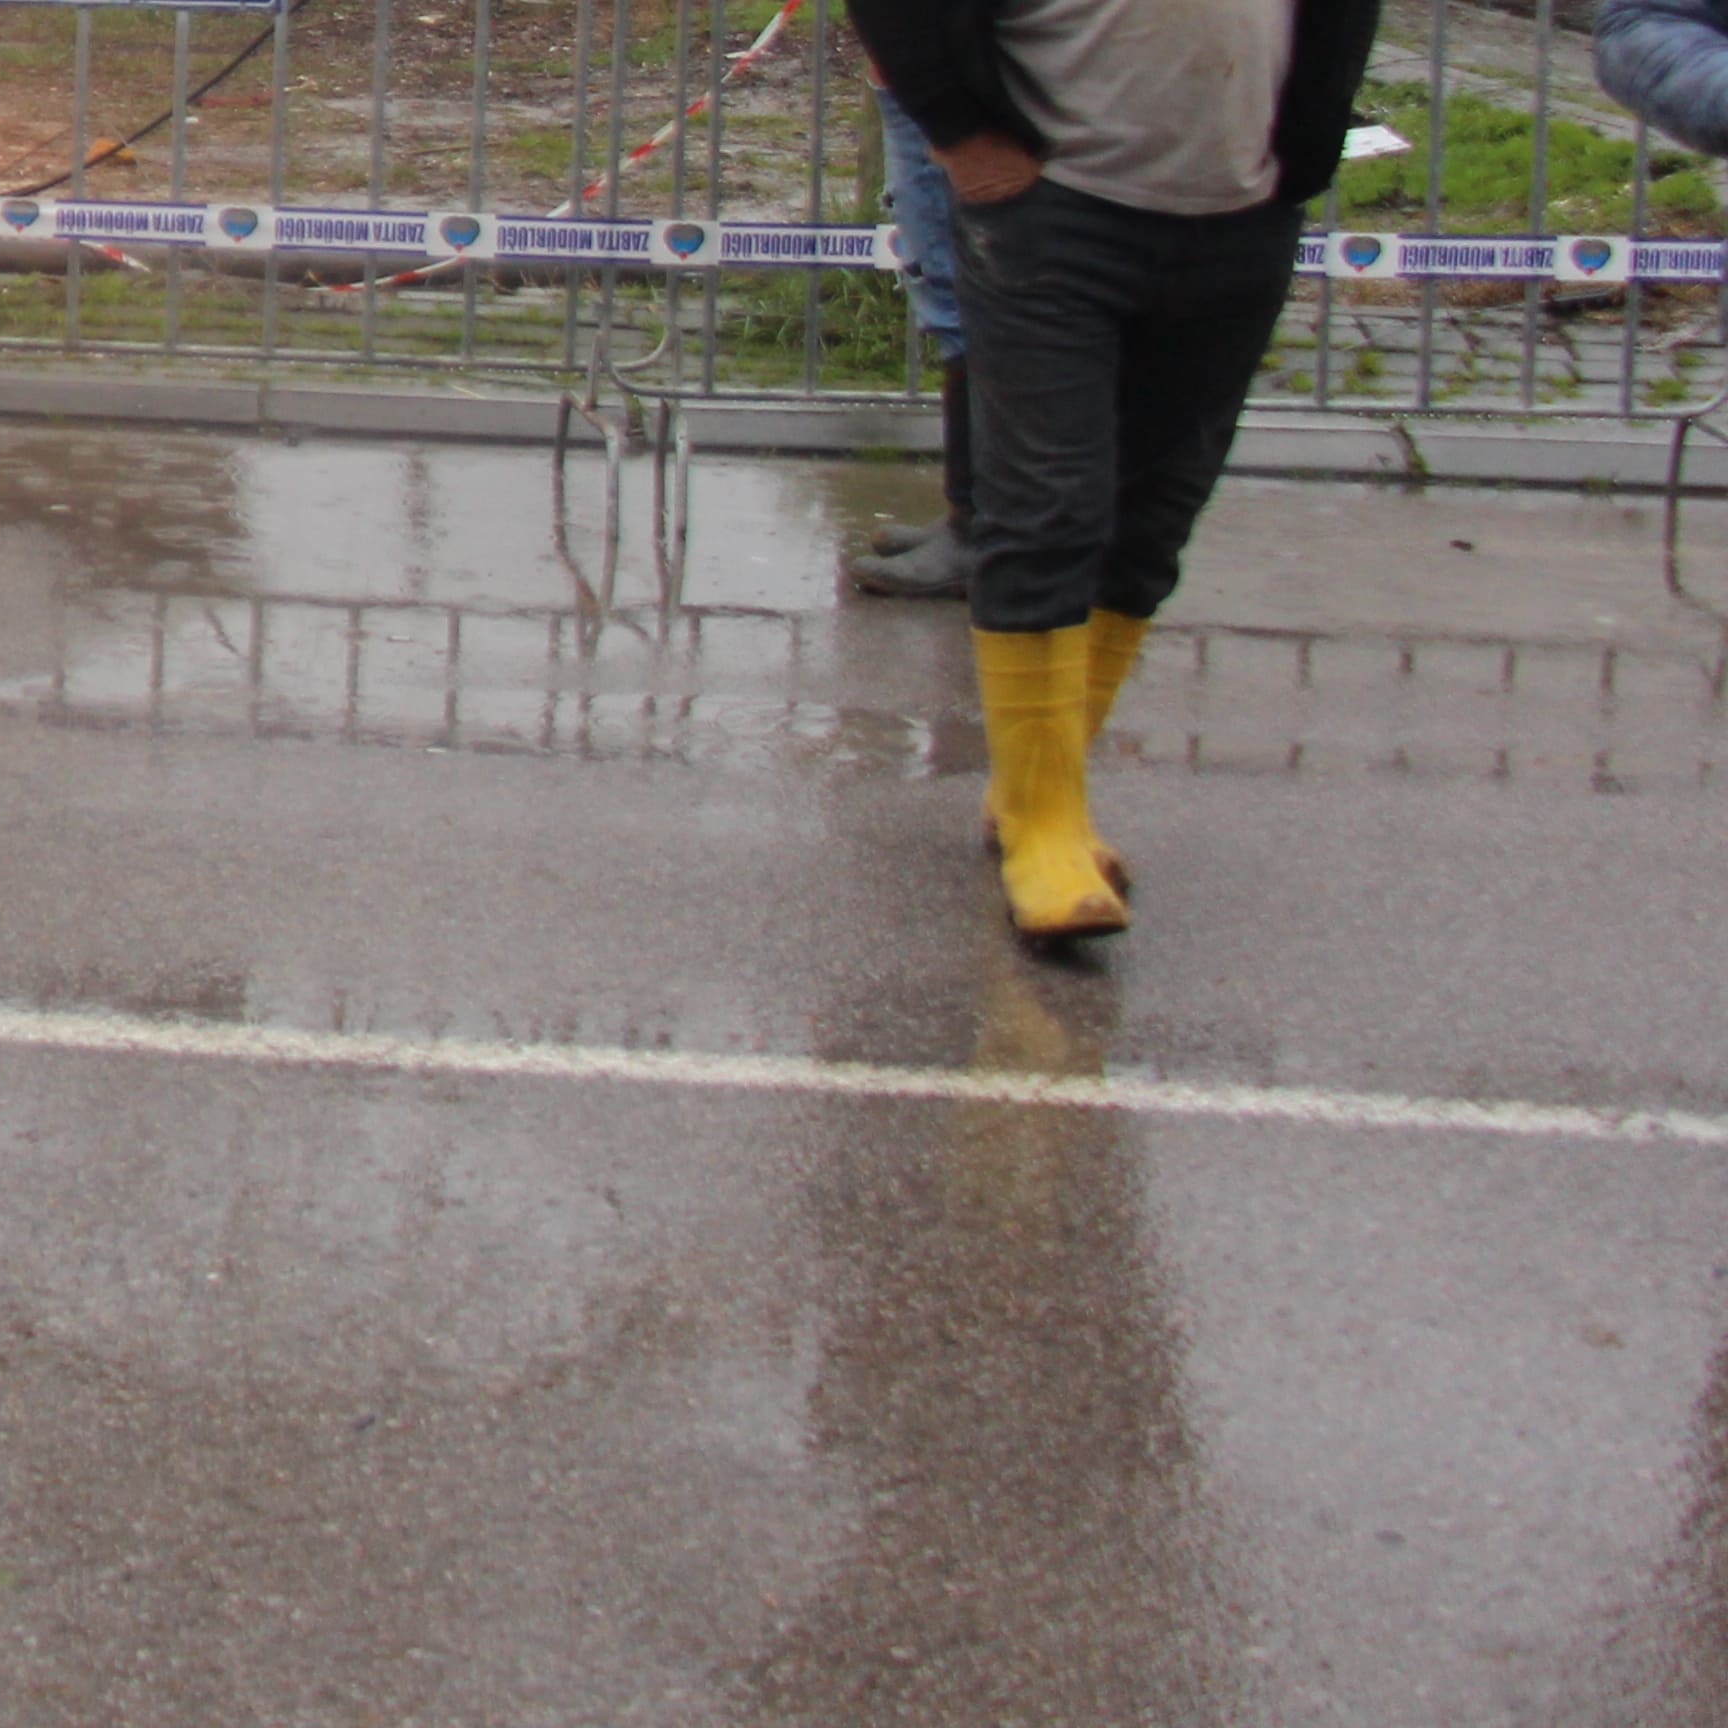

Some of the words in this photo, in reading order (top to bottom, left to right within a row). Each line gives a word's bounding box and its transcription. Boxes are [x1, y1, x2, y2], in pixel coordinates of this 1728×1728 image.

[152, 214, 205, 234] ZABITA
[373, 223, 425, 245] ZABITA
[597, 231, 650, 253] ZABITA
[823, 234, 874, 256] ZABITA
[1502, 247, 1554, 269] ZABITA
